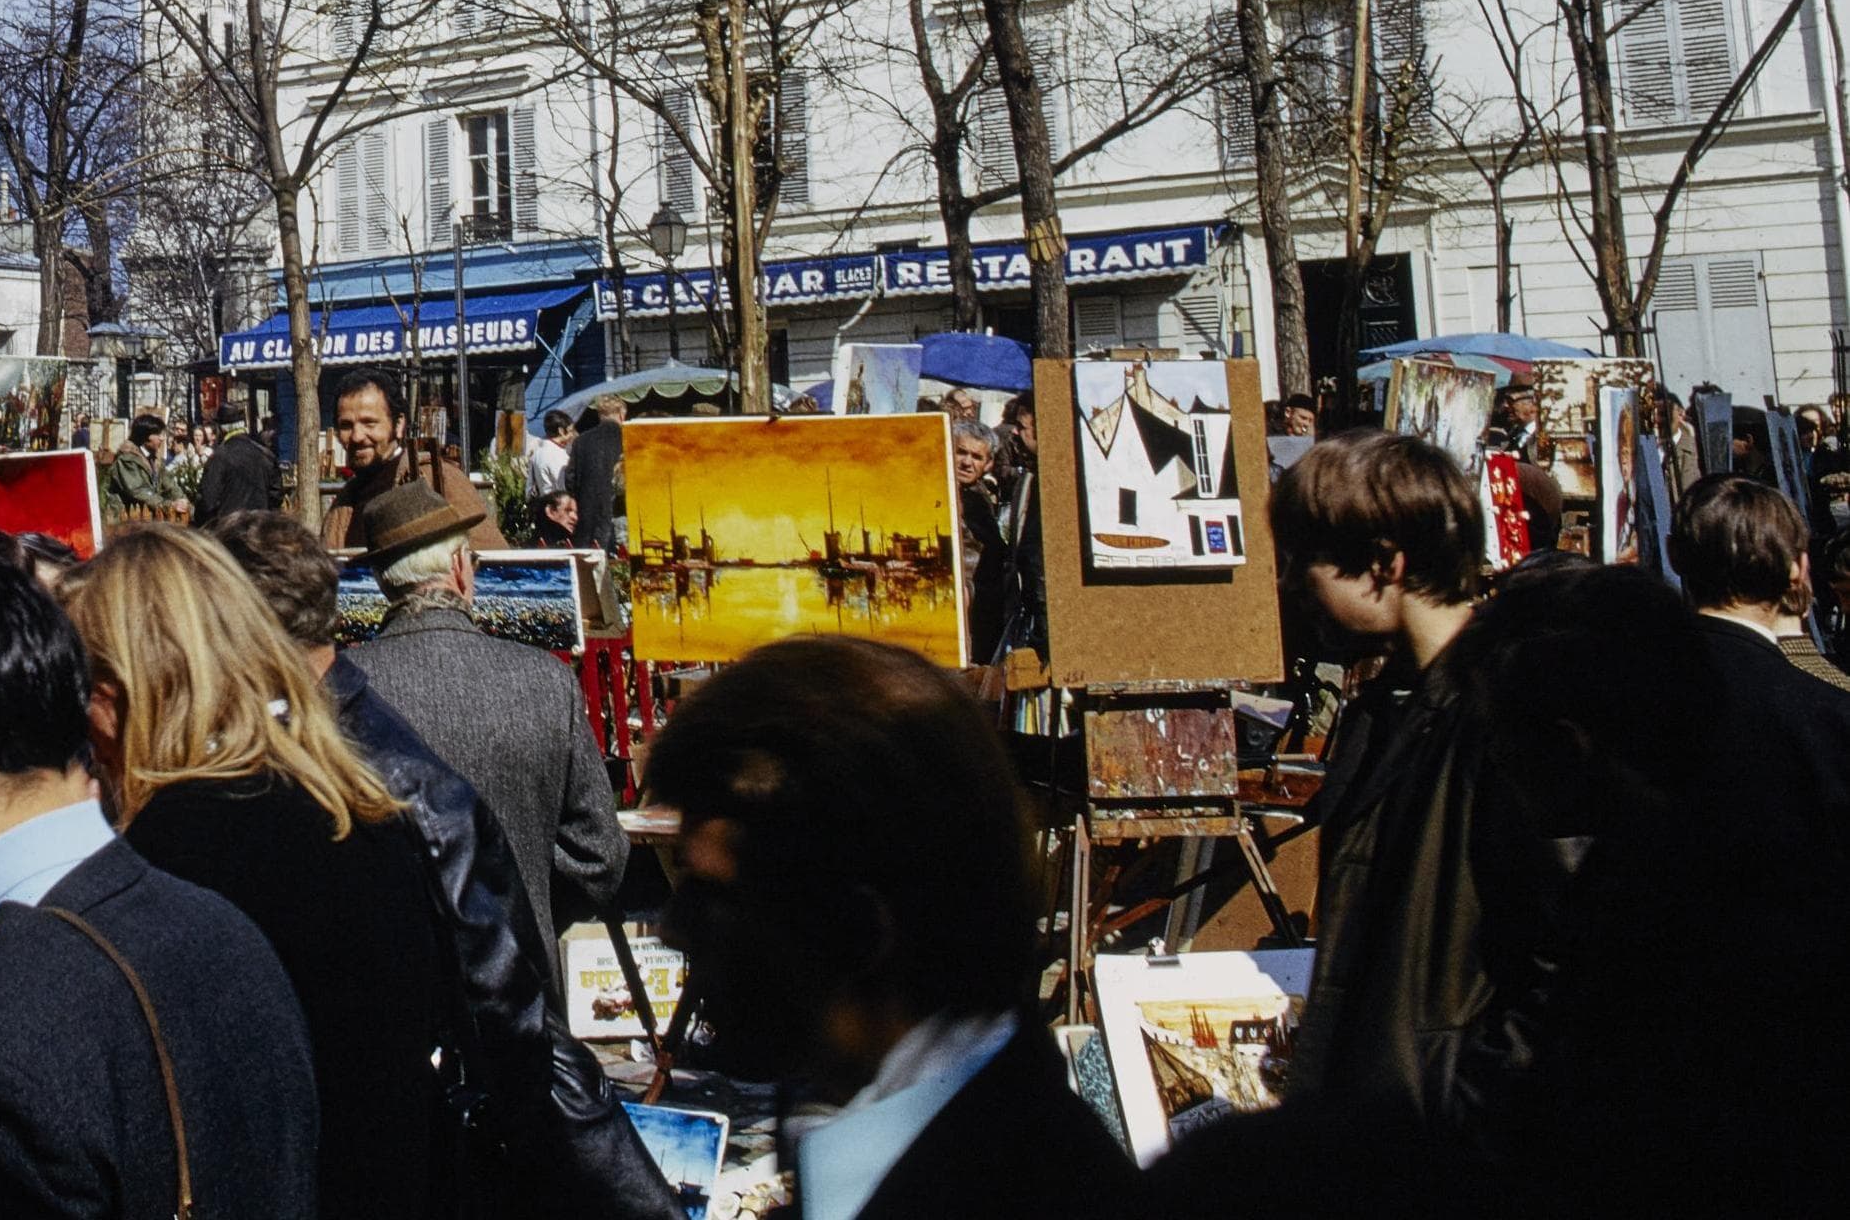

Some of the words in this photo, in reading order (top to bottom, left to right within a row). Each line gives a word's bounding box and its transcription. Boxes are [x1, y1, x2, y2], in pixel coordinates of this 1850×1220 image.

[896, 238, 1192, 285] RETARANT
[752, 269, 825, 297] BAR
[835, 267, 872, 284] GLACES
[229, 341, 255, 362] AU
[262, 334, 348, 359] CLRON
[354, 331, 395, 353] DES
